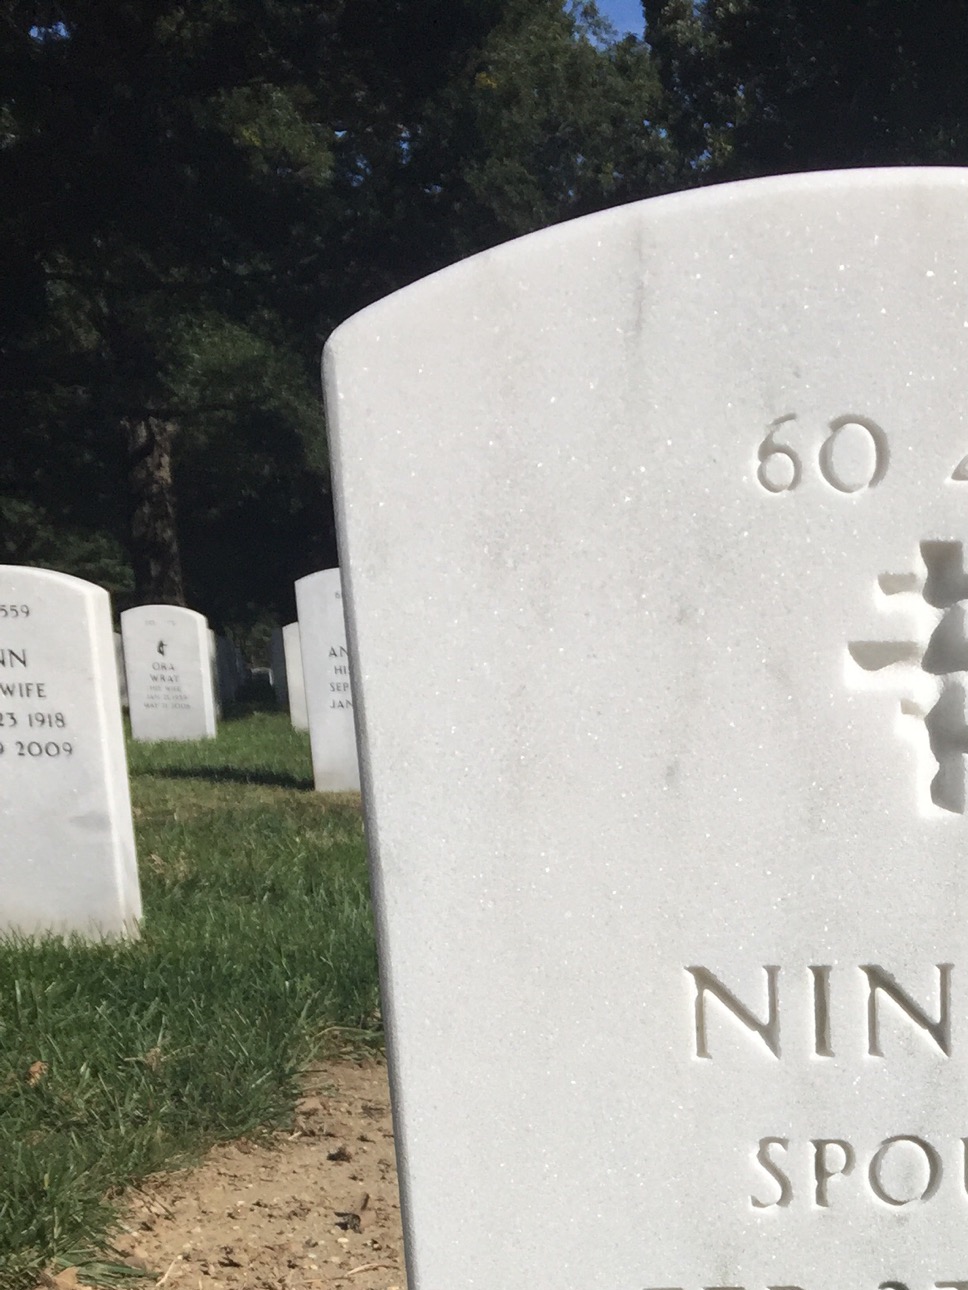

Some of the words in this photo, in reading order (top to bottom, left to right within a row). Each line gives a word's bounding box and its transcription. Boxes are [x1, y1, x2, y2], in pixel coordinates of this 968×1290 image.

[757, 413, 891, 493] 60
[0, 604, 30, 618] 559
[334, 665, 351, 675] HI
[0, 682, 47, 698] WIFE
[330, 682, 349, 692] SEP
[28, 711, 66, 729] 1918
[15, 740, 73, 758] 2009
